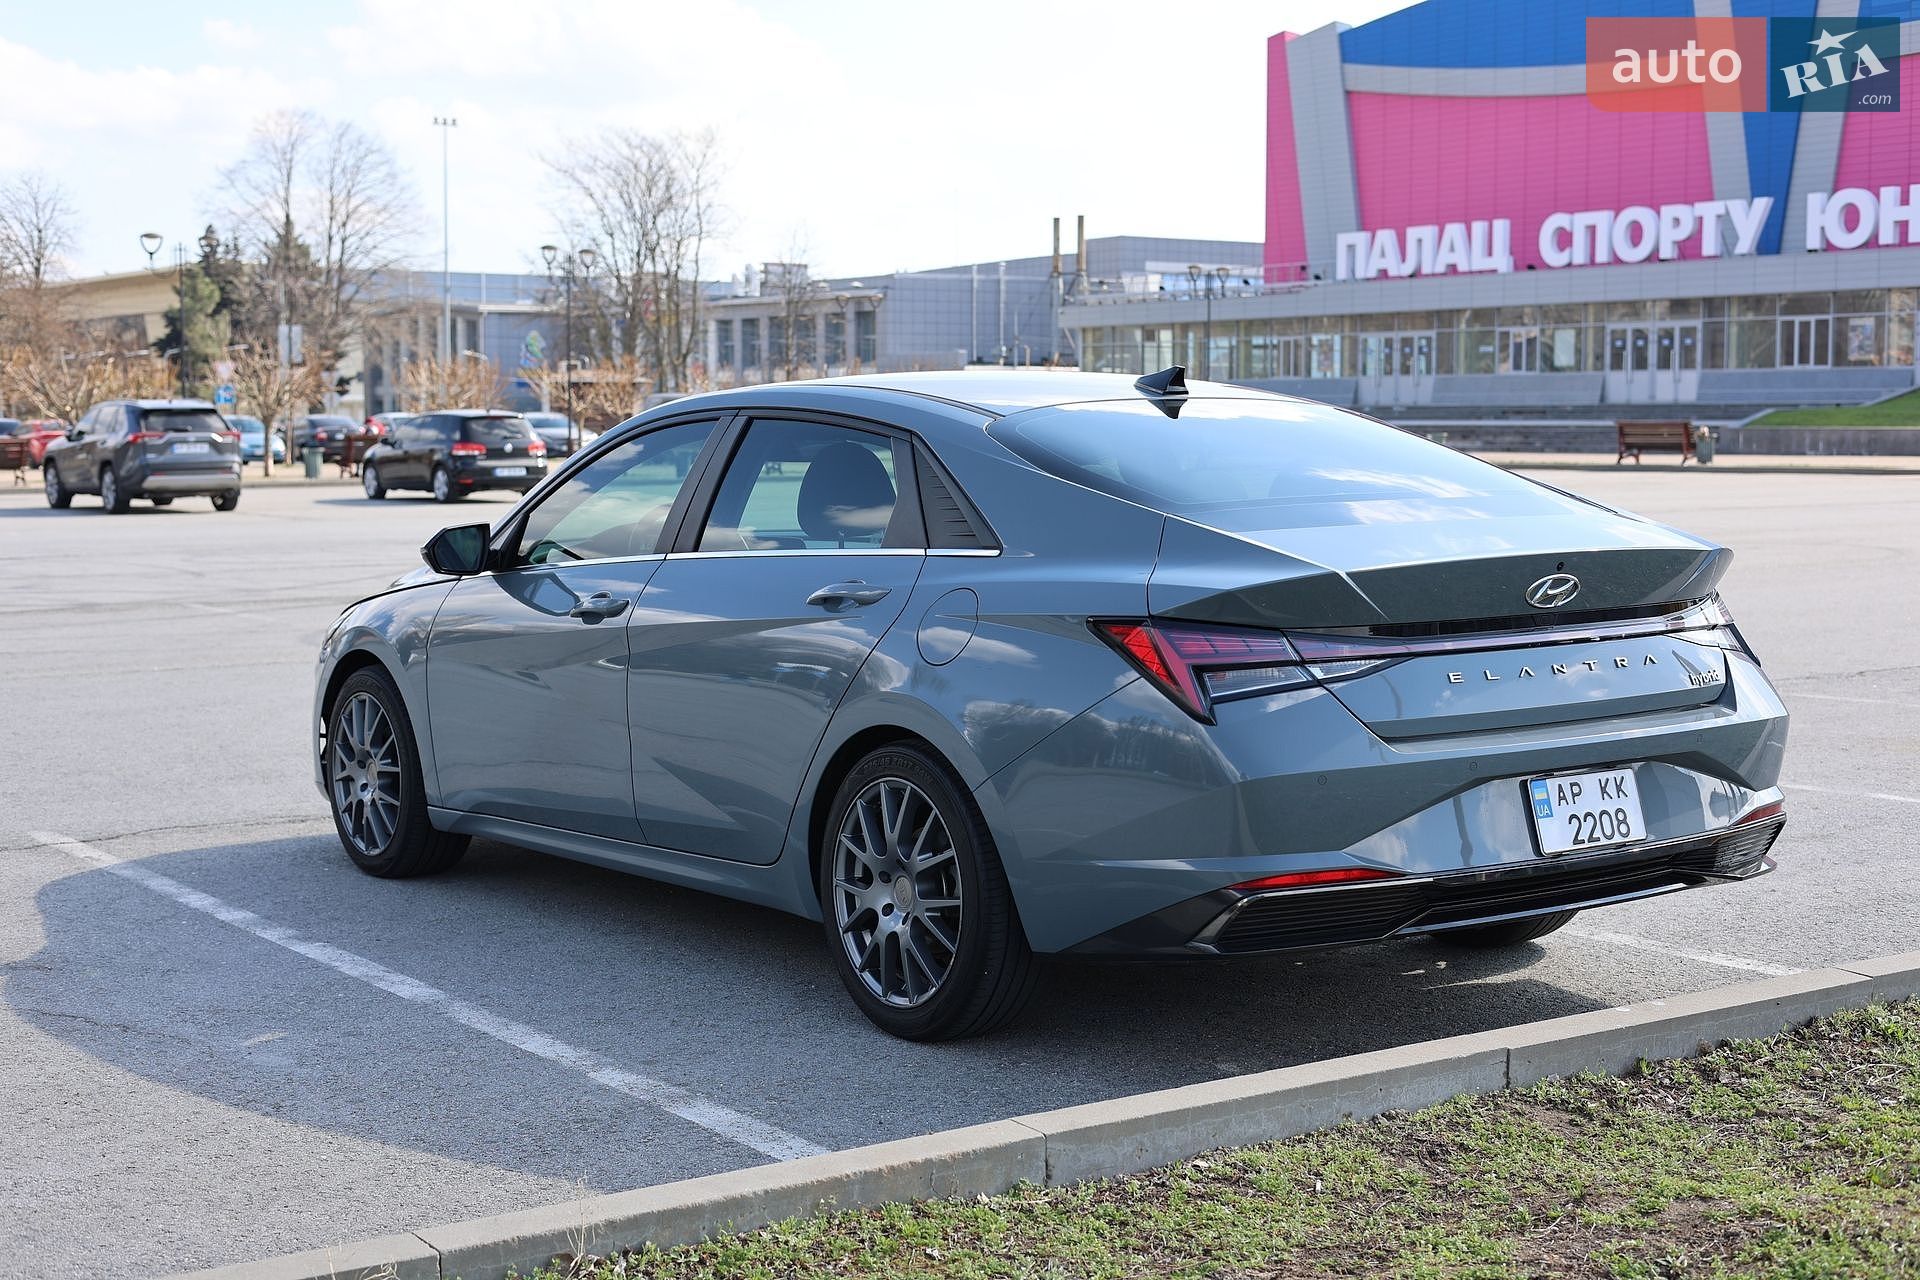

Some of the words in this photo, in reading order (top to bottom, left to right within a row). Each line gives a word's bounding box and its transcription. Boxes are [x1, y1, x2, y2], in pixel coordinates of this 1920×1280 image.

[1335, 218, 1514, 280] ПАЛАЦ
[1538, 196, 1775, 268] СПОРТУ
[1806, 183, 1920, 250] ЮН
[1448, 654, 1658, 684] ELANTRA
[1688, 669, 1721, 687] hybrid
[1557, 781, 1583, 807] AP
[1598, 775, 1629, 801] KK
[1536, 804, 1552, 817] UA
[1568, 807, 1631, 846] 2208
